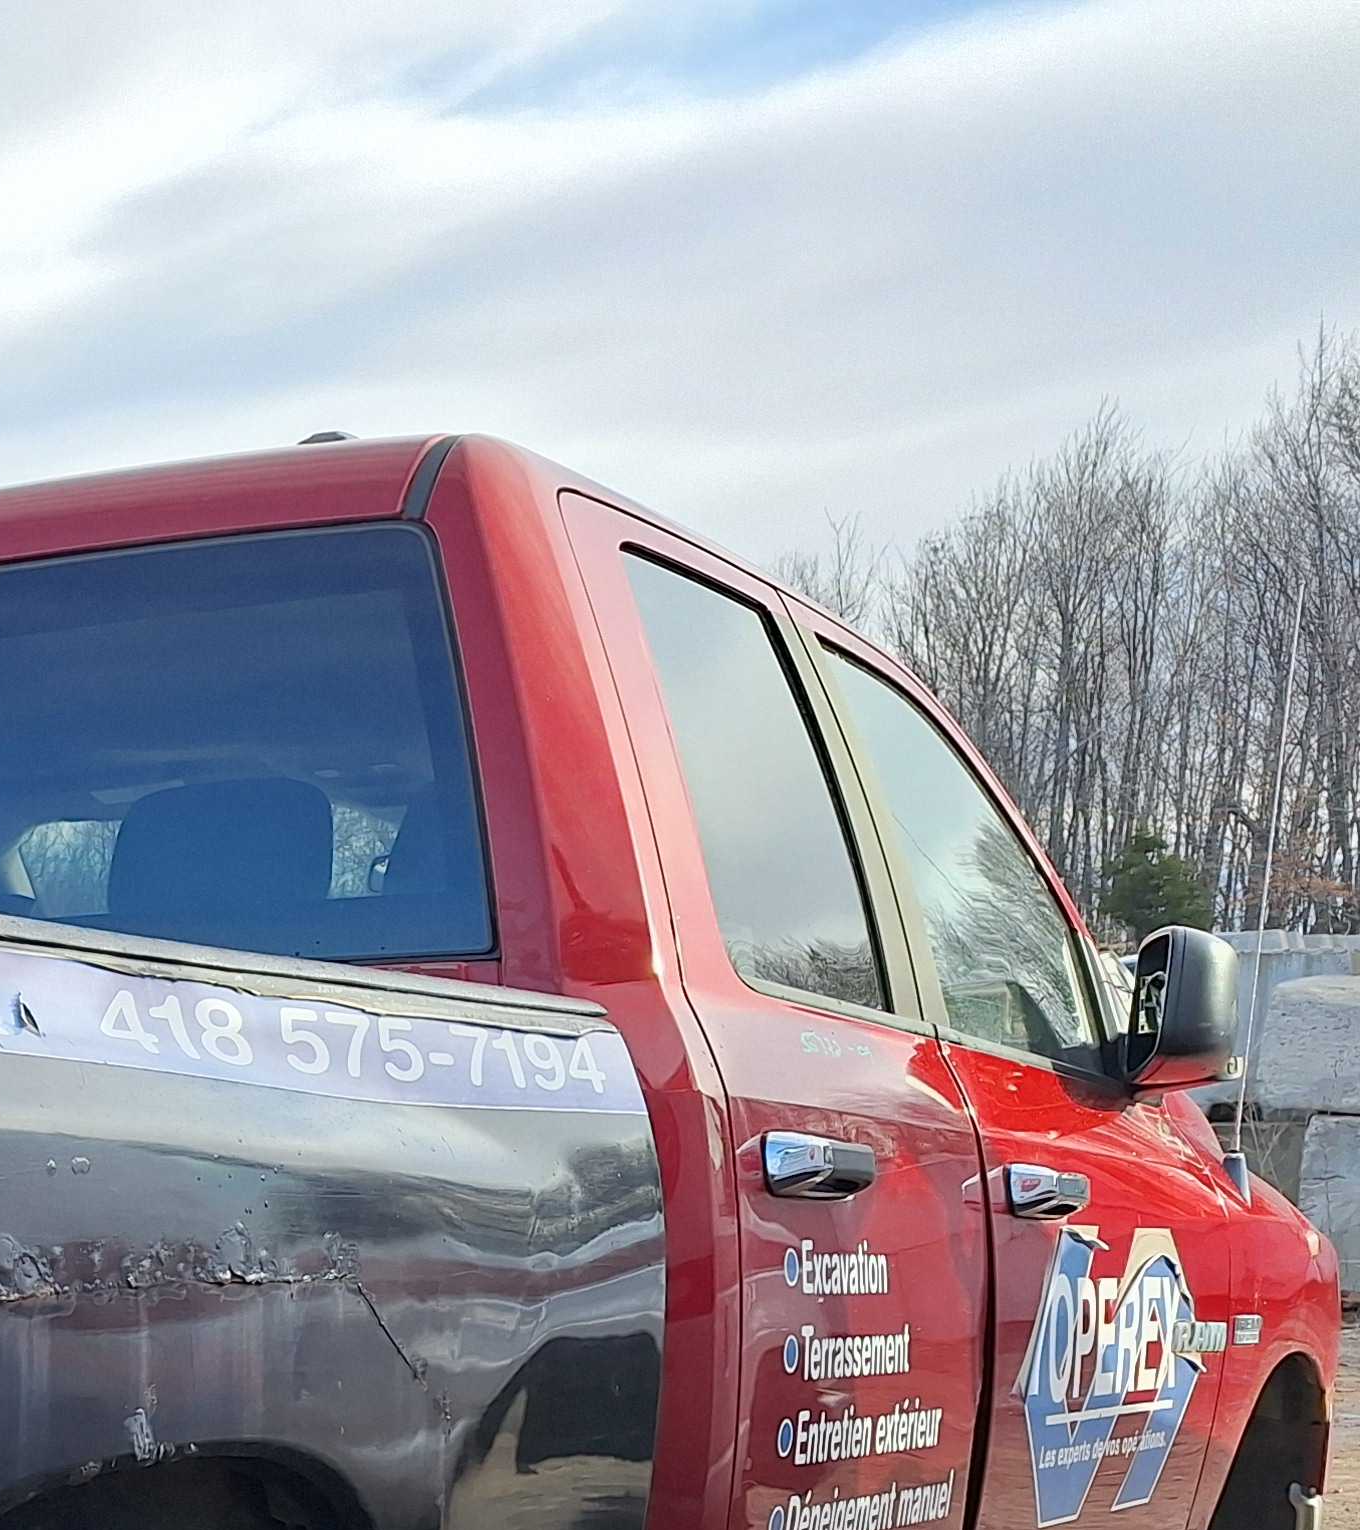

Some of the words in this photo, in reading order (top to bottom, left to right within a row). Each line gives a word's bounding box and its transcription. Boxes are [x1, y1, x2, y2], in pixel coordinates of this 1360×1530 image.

[98, 989, 254, 1067] 418
[279, 1006, 607, 1094] 575-7194
[800, 1238, 889, 1295] Excavation
[800, 1322, 911, 1382] Terrassement
[1048, 1273, 1181, 1403] OPEREX
[793, 1403, 873, 1466] Entretien
[875, 1397, 943, 1455] extérieur
[1038, 1446, 1056, 1469] Les
[1057, 1440, 1091, 1470] experts
[896, 1468, 956, 1528] manuel
